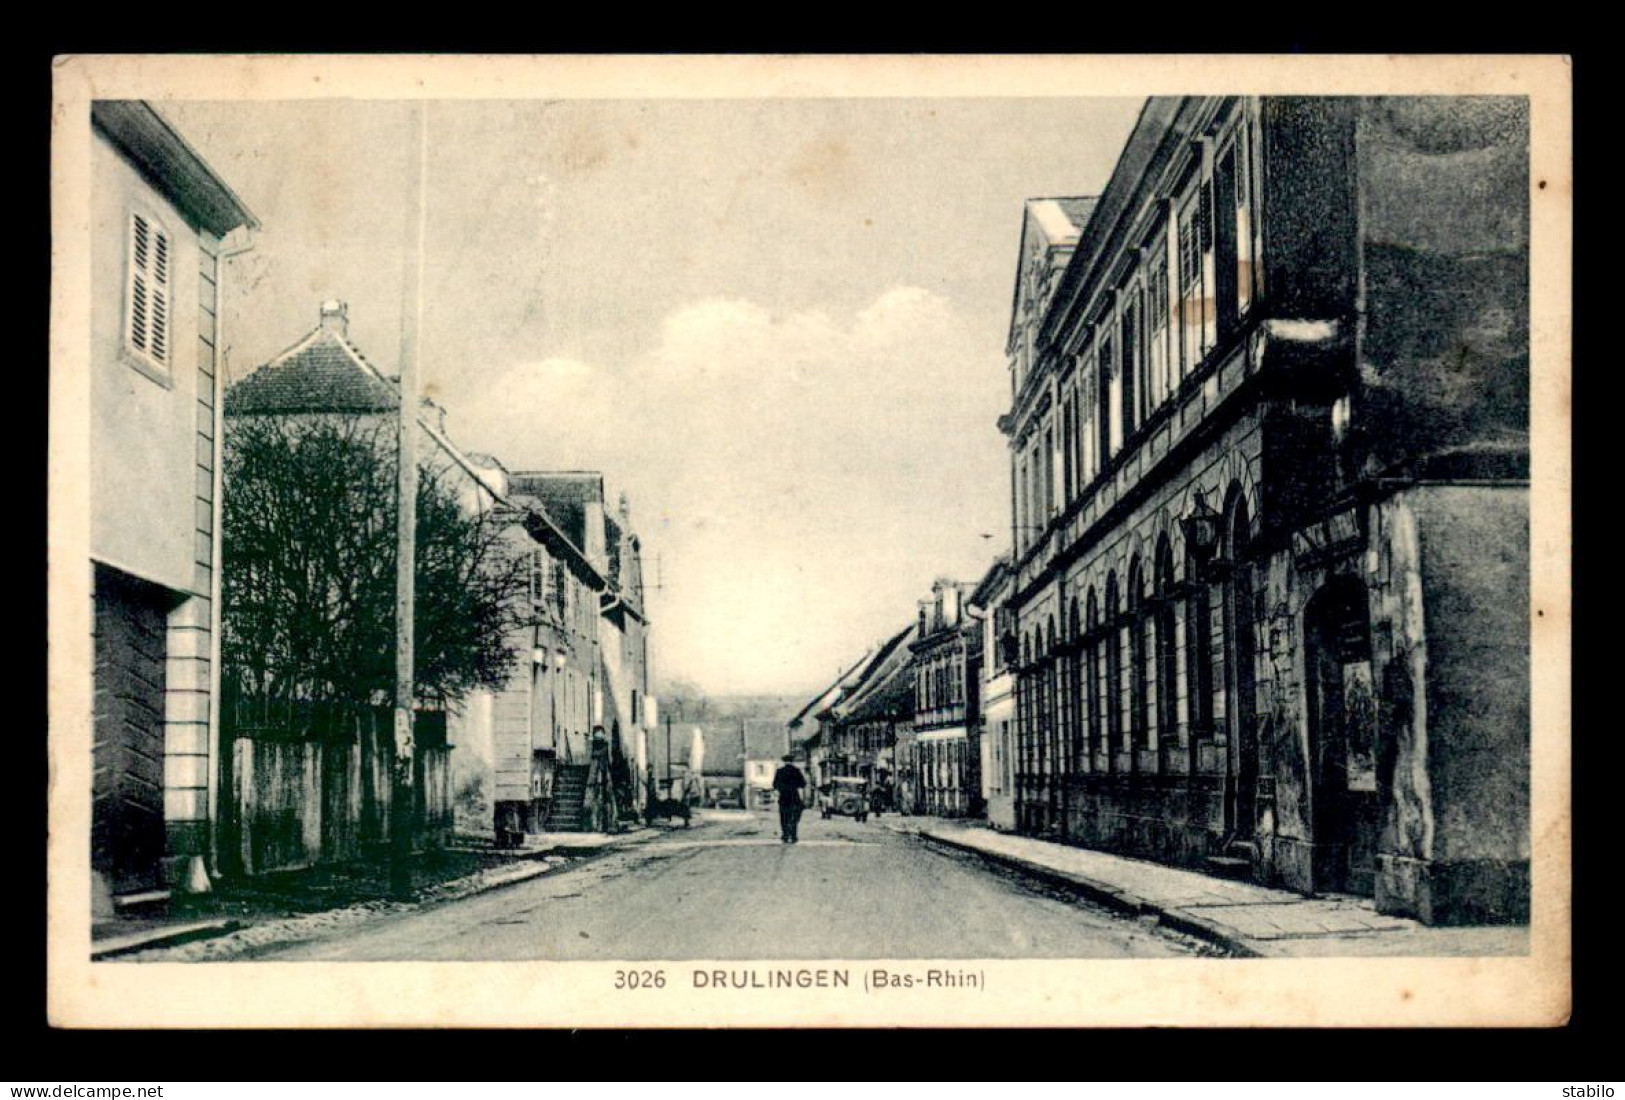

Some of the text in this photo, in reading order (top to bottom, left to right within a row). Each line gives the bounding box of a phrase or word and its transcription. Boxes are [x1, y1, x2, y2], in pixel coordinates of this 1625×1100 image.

[615, 970, 984, 991] 3026 DRULINGEN (Bas-Rhin)
